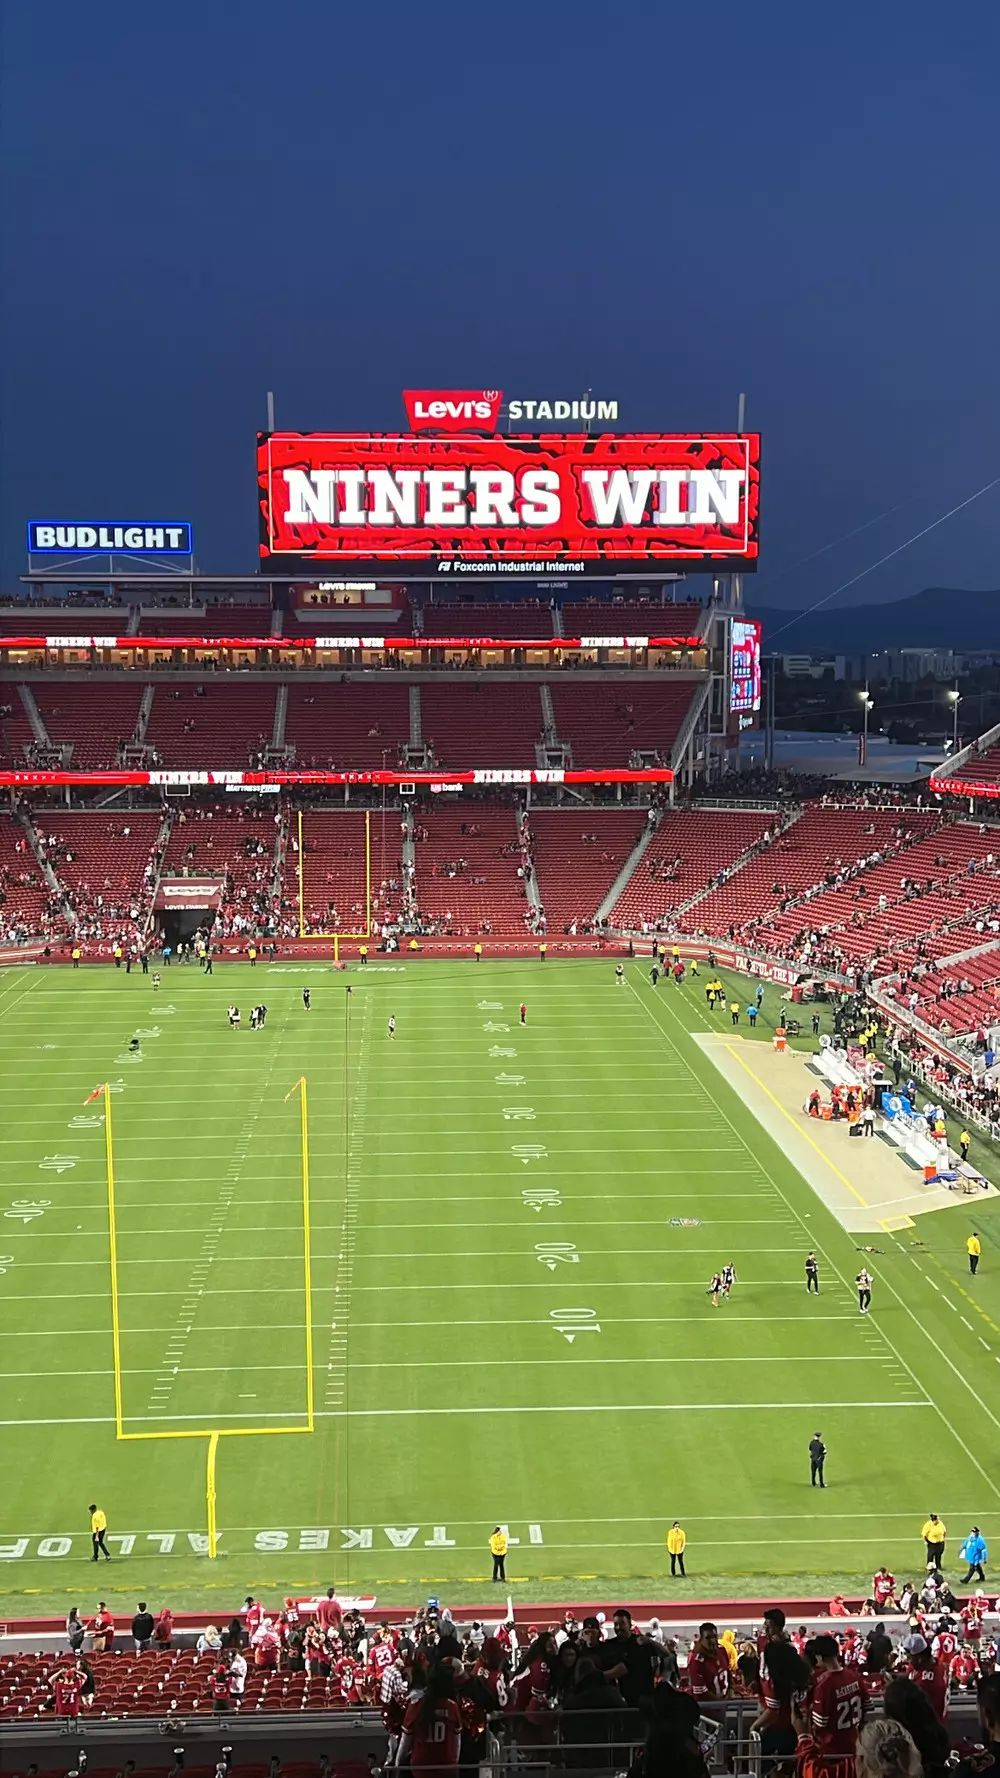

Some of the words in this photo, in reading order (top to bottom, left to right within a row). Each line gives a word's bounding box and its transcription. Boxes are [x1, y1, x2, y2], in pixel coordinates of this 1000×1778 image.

[508, 400, 618, 420] STADIUM
[283, 469, 560, 525] NINERS
[582, 469, 746, 525] WIN
[453, 561, 497, 572] Foxconn
[498, 561, 545, 572] Industrial
[546, 561, 585, 572] Internet
[502, 1107, 537, 1120] 50
[511, 1144, 549, 1159] 40
[521, 1189, 562, 1207] 30
[534, 1242, 580, 1263] 20
[549, 1308, 601, 1333] 10
[254, 1526, 456, 1550] TAKES
[375, 1646, 392, 1667] 23
[837, 1695, 862, 1730] 23
